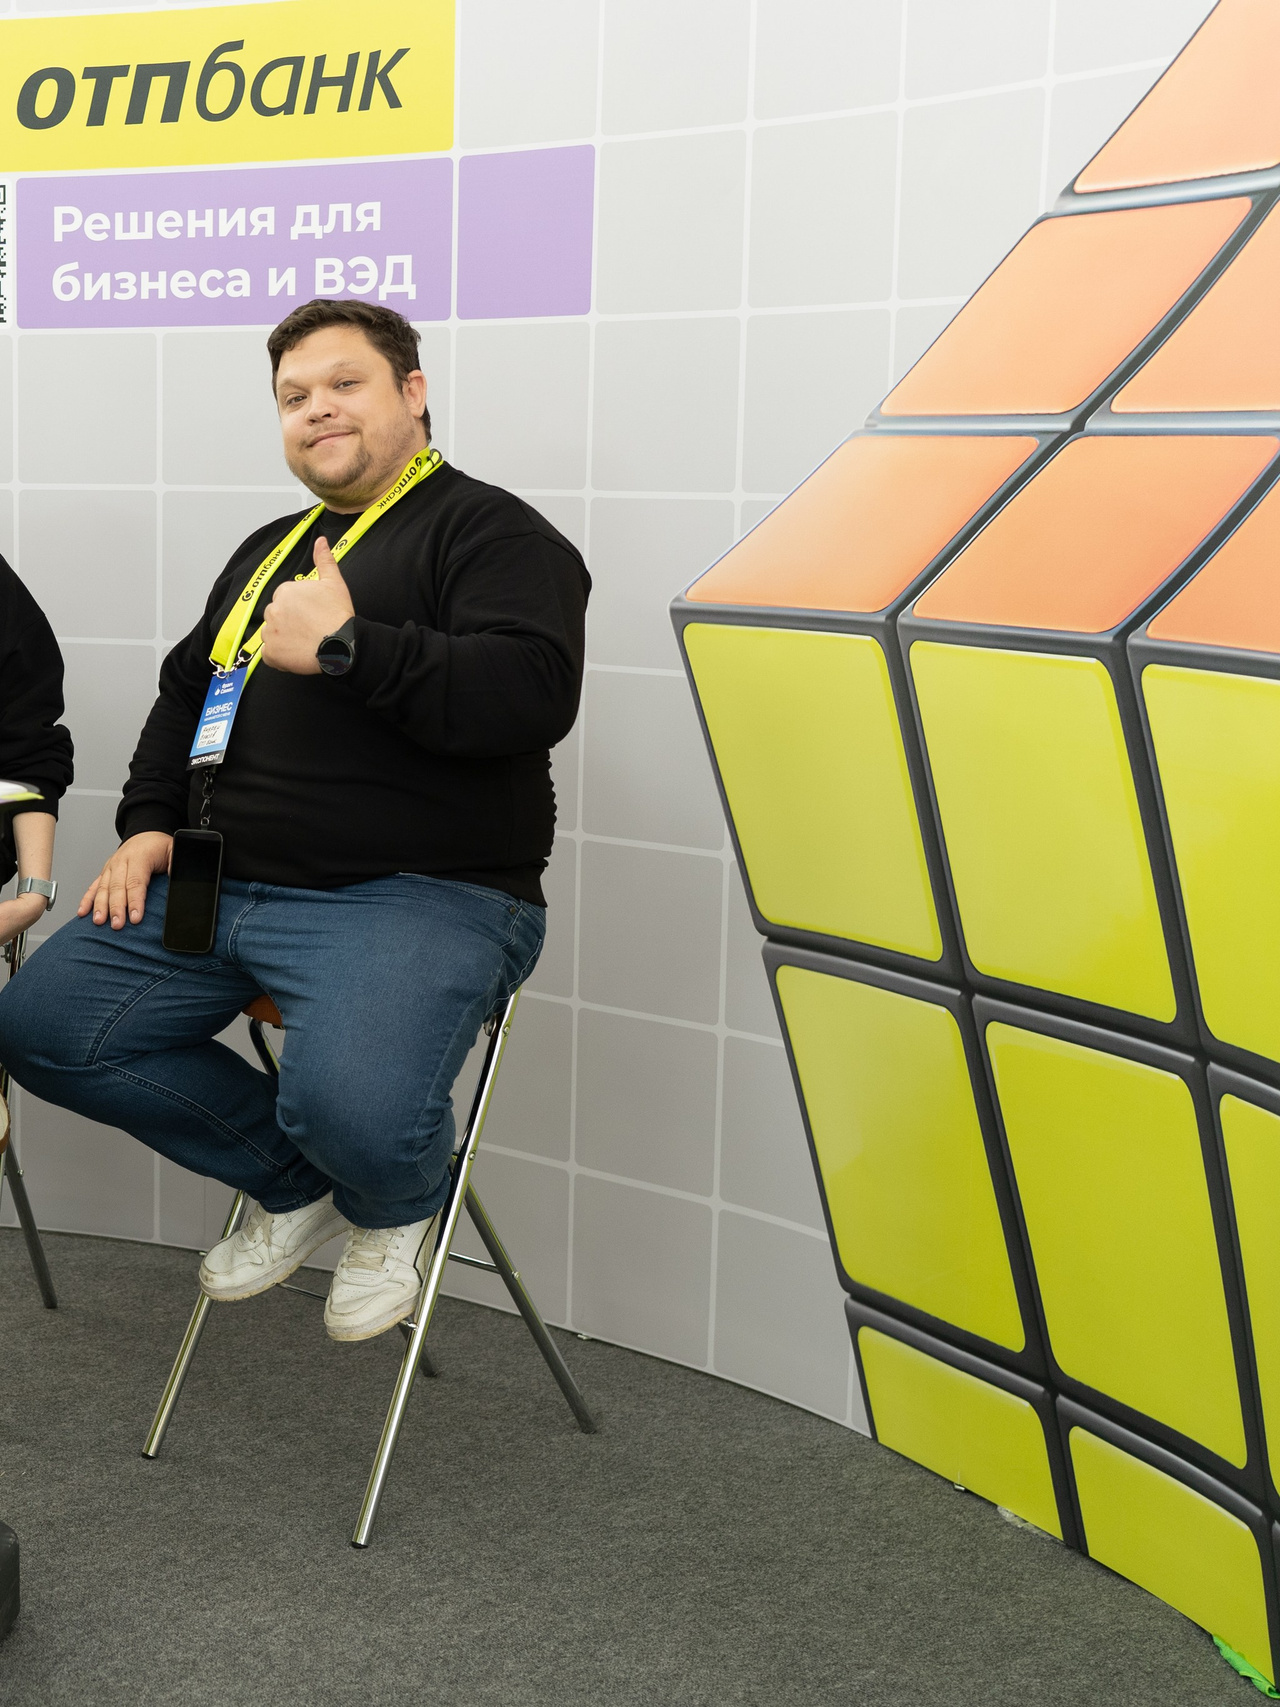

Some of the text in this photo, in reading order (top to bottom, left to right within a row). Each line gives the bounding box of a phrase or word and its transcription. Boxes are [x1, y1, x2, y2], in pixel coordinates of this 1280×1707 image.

[16, 39, 411, 131] отпбанк
[52, 201, 382, 243] Решения для
[51, 254, 417, 302] бизнеса и ВЭД
